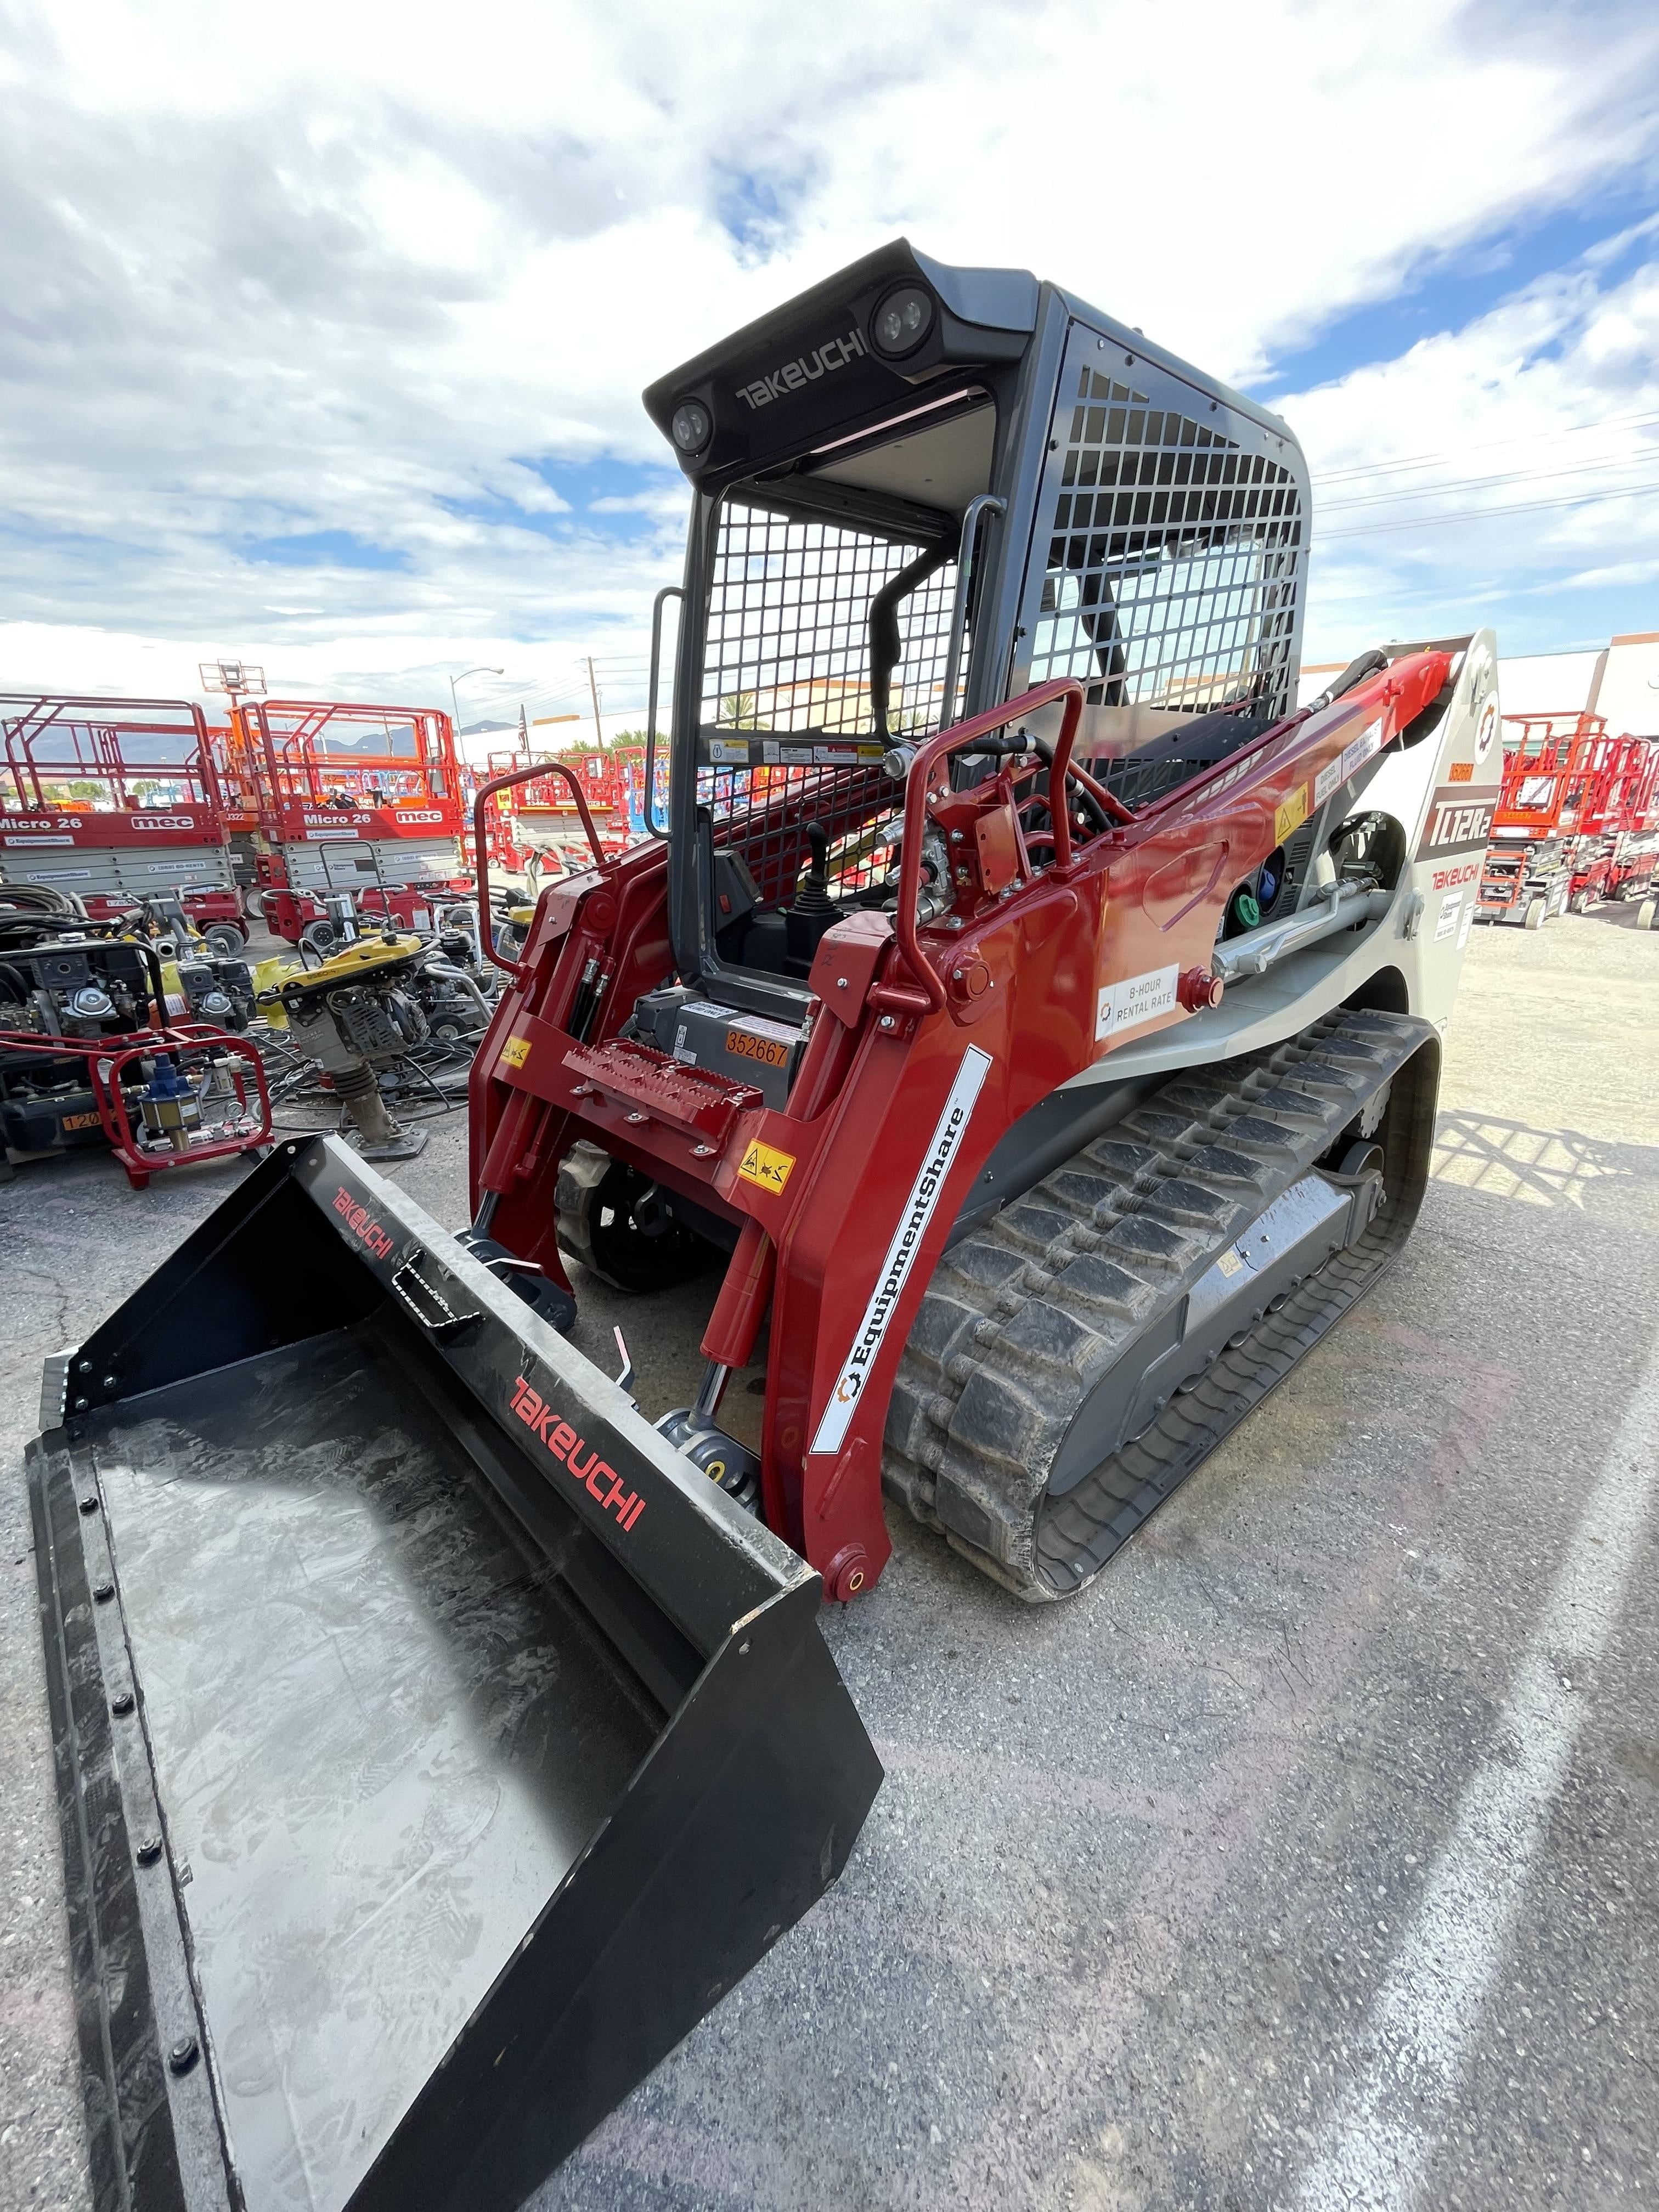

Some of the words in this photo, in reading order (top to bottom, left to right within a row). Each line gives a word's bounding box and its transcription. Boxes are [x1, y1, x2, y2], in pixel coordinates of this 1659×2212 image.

[1344, 743, 1359, 763] DIESEL
[1349, 753, 1362, 771] FLUID
[1363, 741, 1374, 758] ONLY
[1321, 765, 1336, 785] DIESEL
[1316, 786, 1328, 802] FUEL
[1328, 774, 1340, 790] ONLY
[0, 818, 52, 829] Micro
[57, 818, 83, 829] 26
[133, 817, 193, 828] mec
[303, 814, 348, 824] Micro
[352, 813, 371, 823] 26
[397, 812, 442, 821] mec
[1129, 978, 1161, 1000] 8-HOUR
[685, 1004, 705, 1012] FLUID
[696, 1002, 733, 1014] HYDRAULIC
[1117, 1000, 1148, 1022] RENTAL
[1151, 991, 1172, 1009] RATE
[727, 1031, 788, 1065] 352667
[850, 1107, 964, 1366] EquipmentShare
